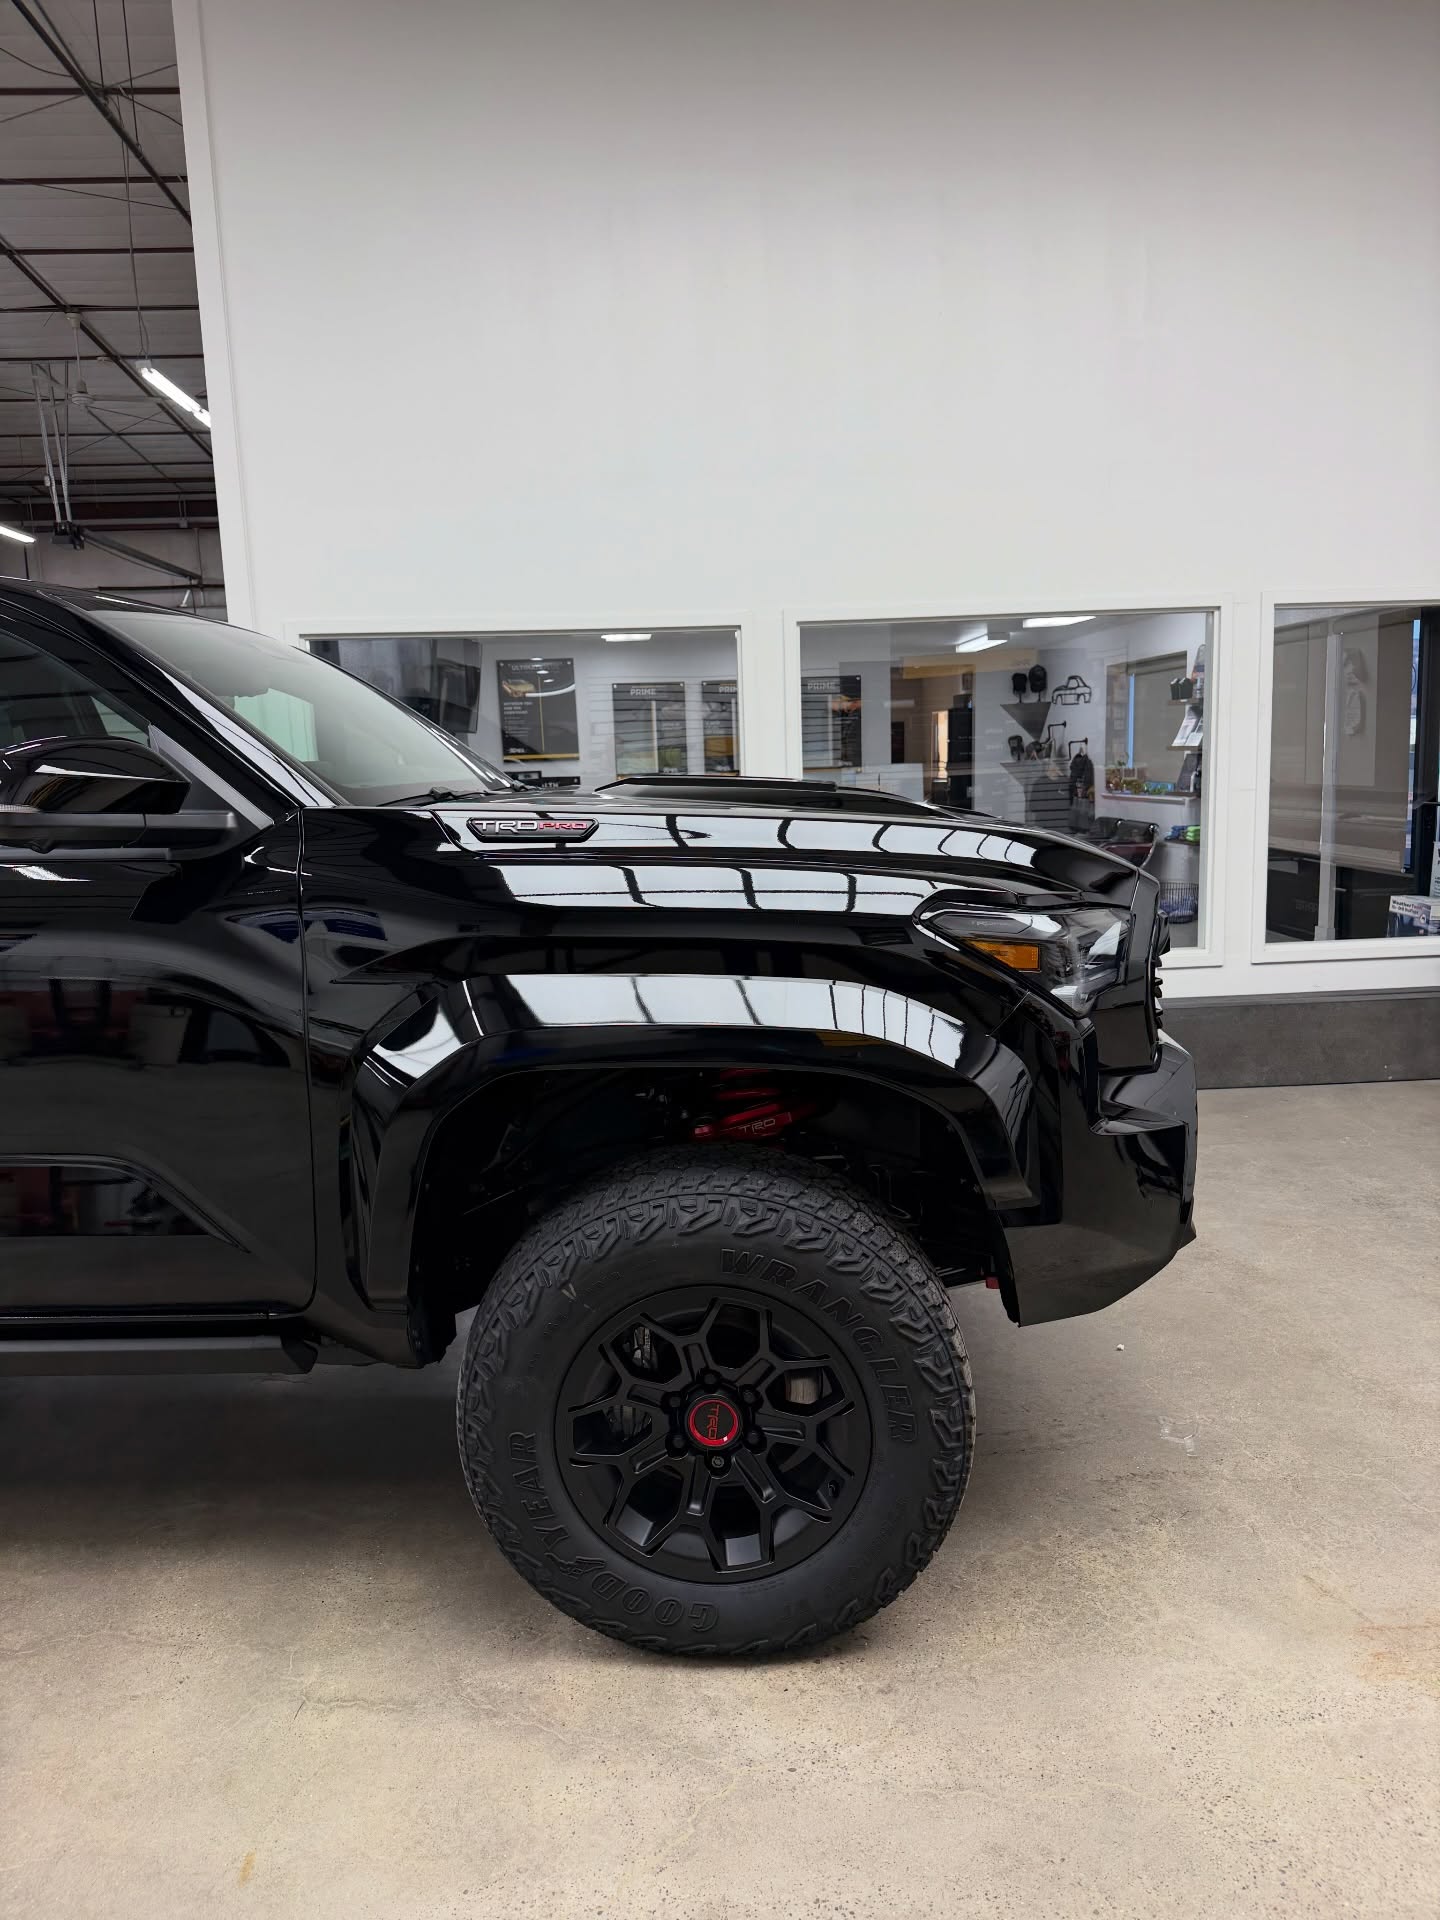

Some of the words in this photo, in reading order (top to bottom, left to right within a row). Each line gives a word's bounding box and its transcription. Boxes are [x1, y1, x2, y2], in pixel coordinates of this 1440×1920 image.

[630, 688, 657, 696] PRIME
[807, 681, 837, 691] PRIME
[475, 820, 518, 834] TRD
[539, 821, 587, 830] PRO
[739, 1118, 776, 1135] TRD
[720, 1247, 921, 1444] WRANGLER
[706, 1403, 720, 1440] TRD
